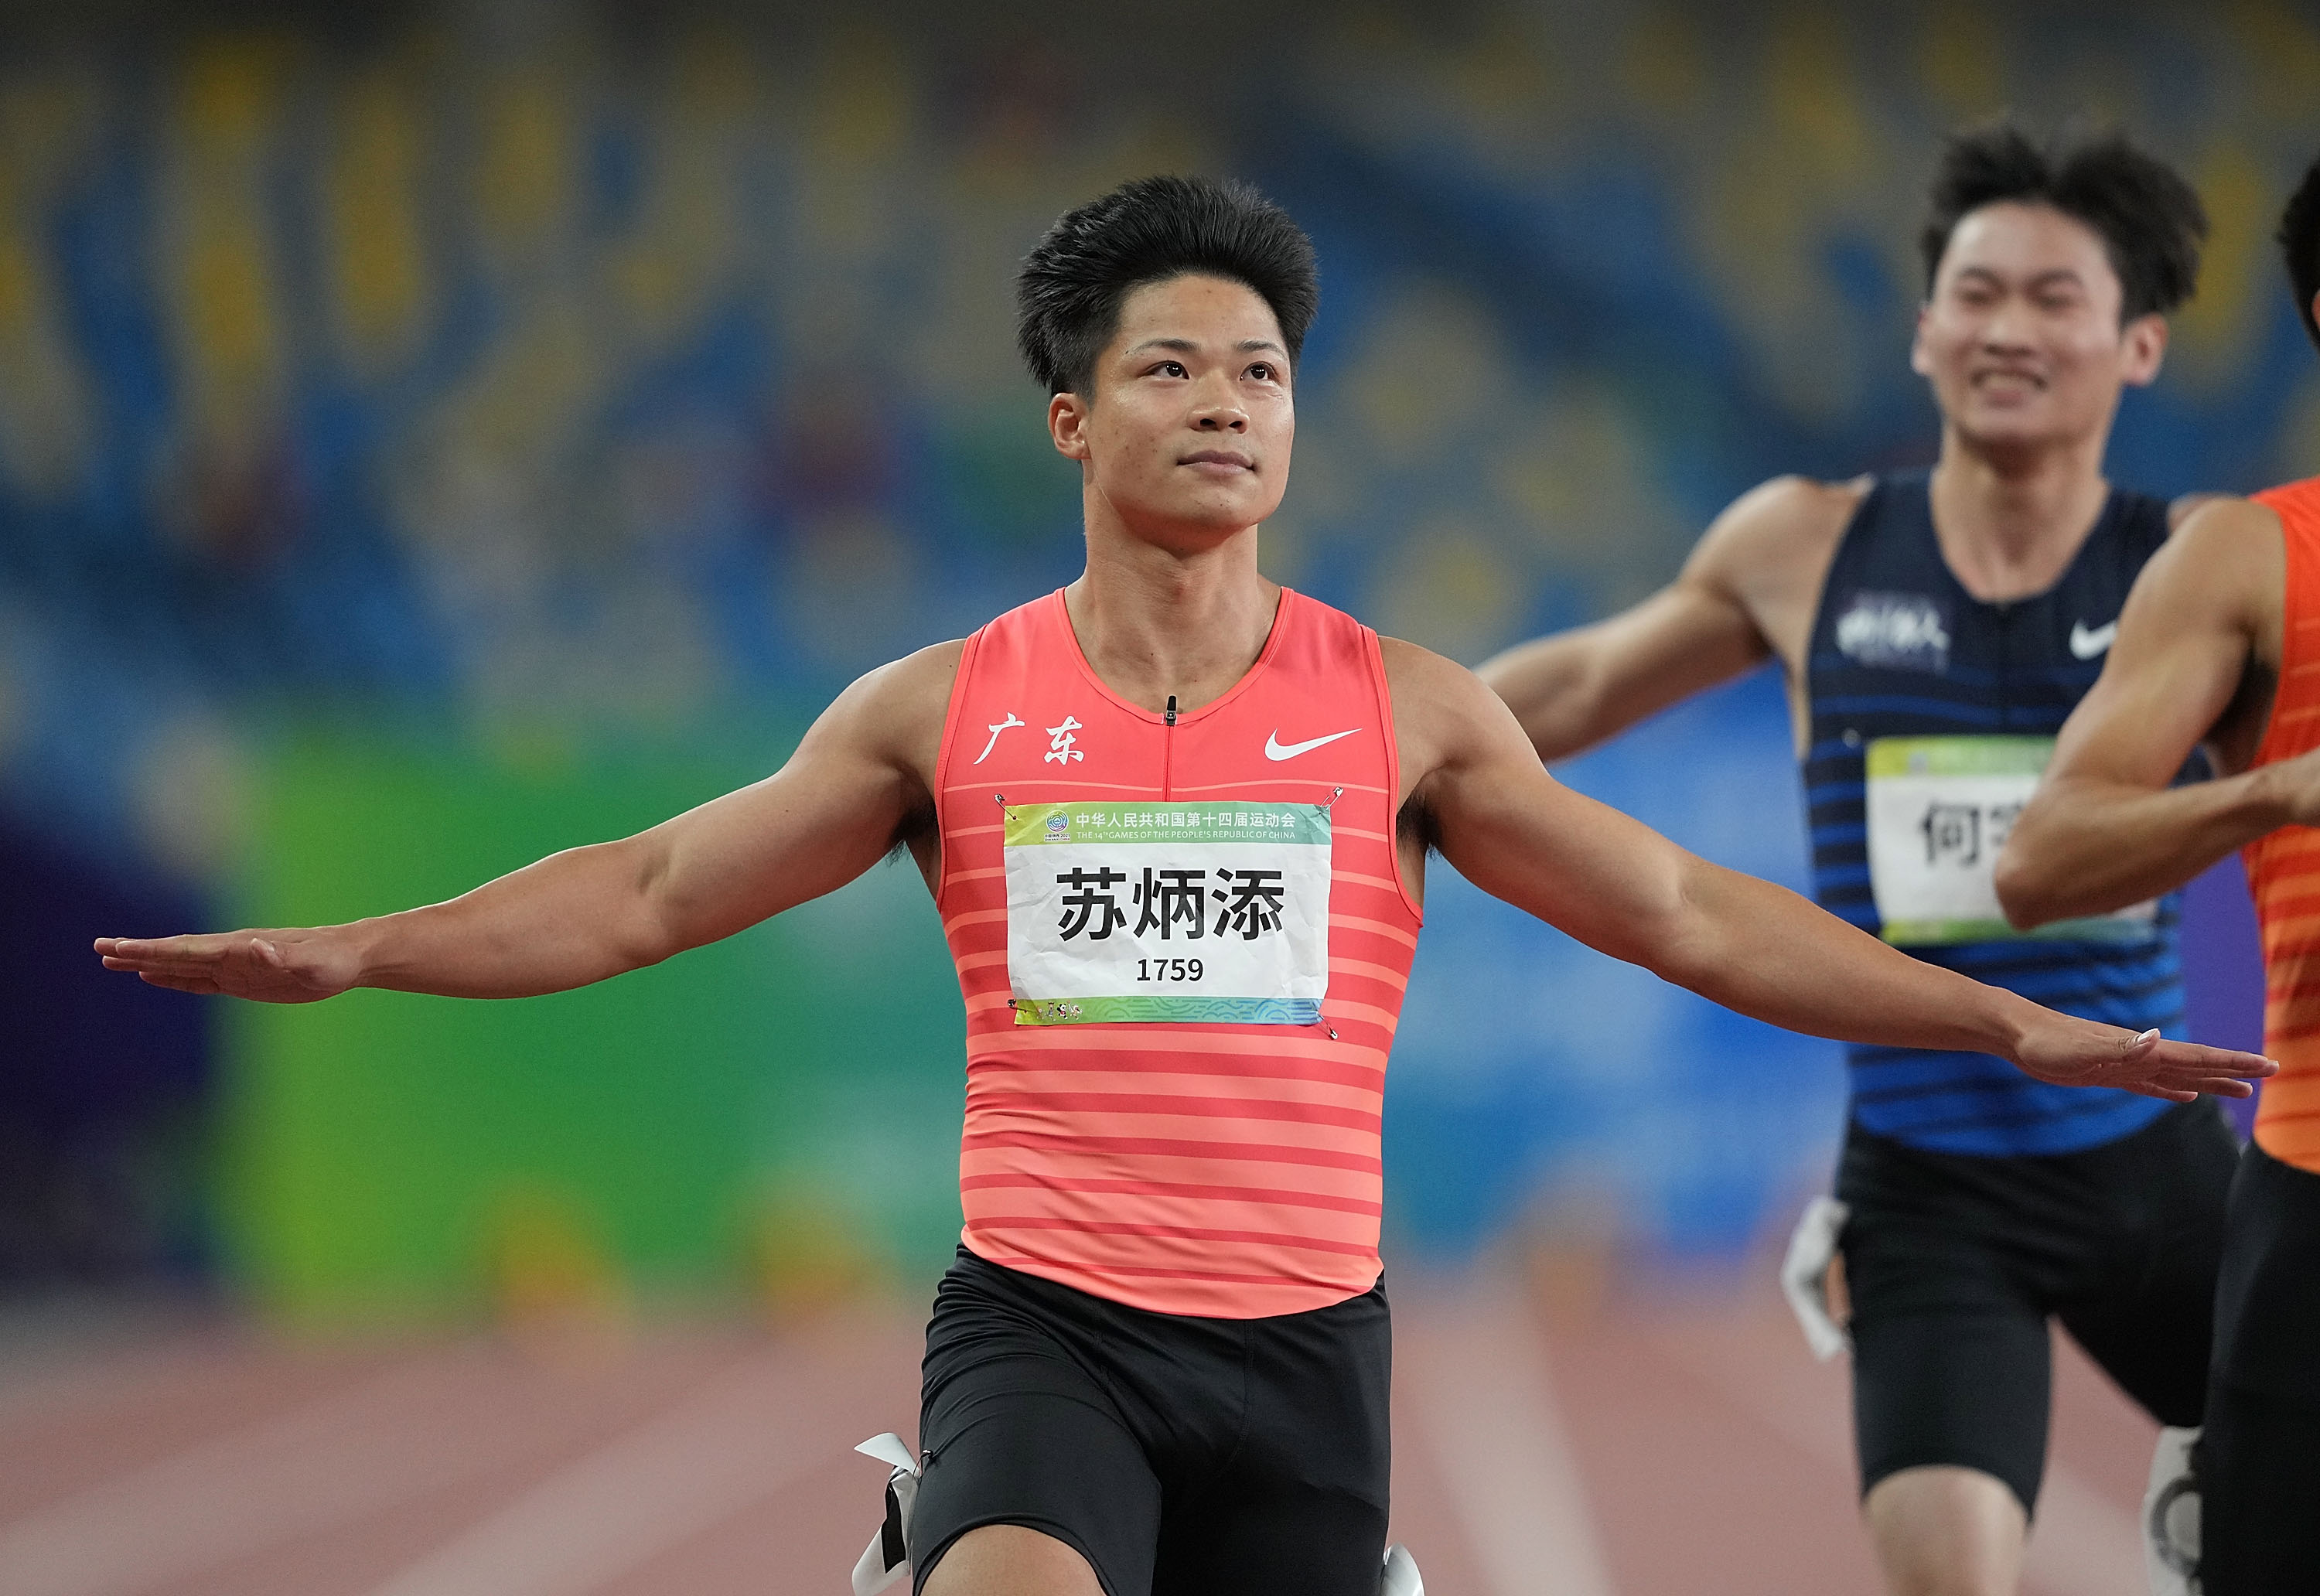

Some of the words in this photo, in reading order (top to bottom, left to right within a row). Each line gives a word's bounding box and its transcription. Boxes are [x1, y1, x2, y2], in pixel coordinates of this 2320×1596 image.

[973, 711, 1084, 766] 广东
[1076, 812, 1295, 828] 中华人民共和国第十四届运动会
[1268, 830, 1296, 839] CHINA
[1056, 866, 1285, 942] 苏炳添
[1136, 958, 1204, 981] 1759
